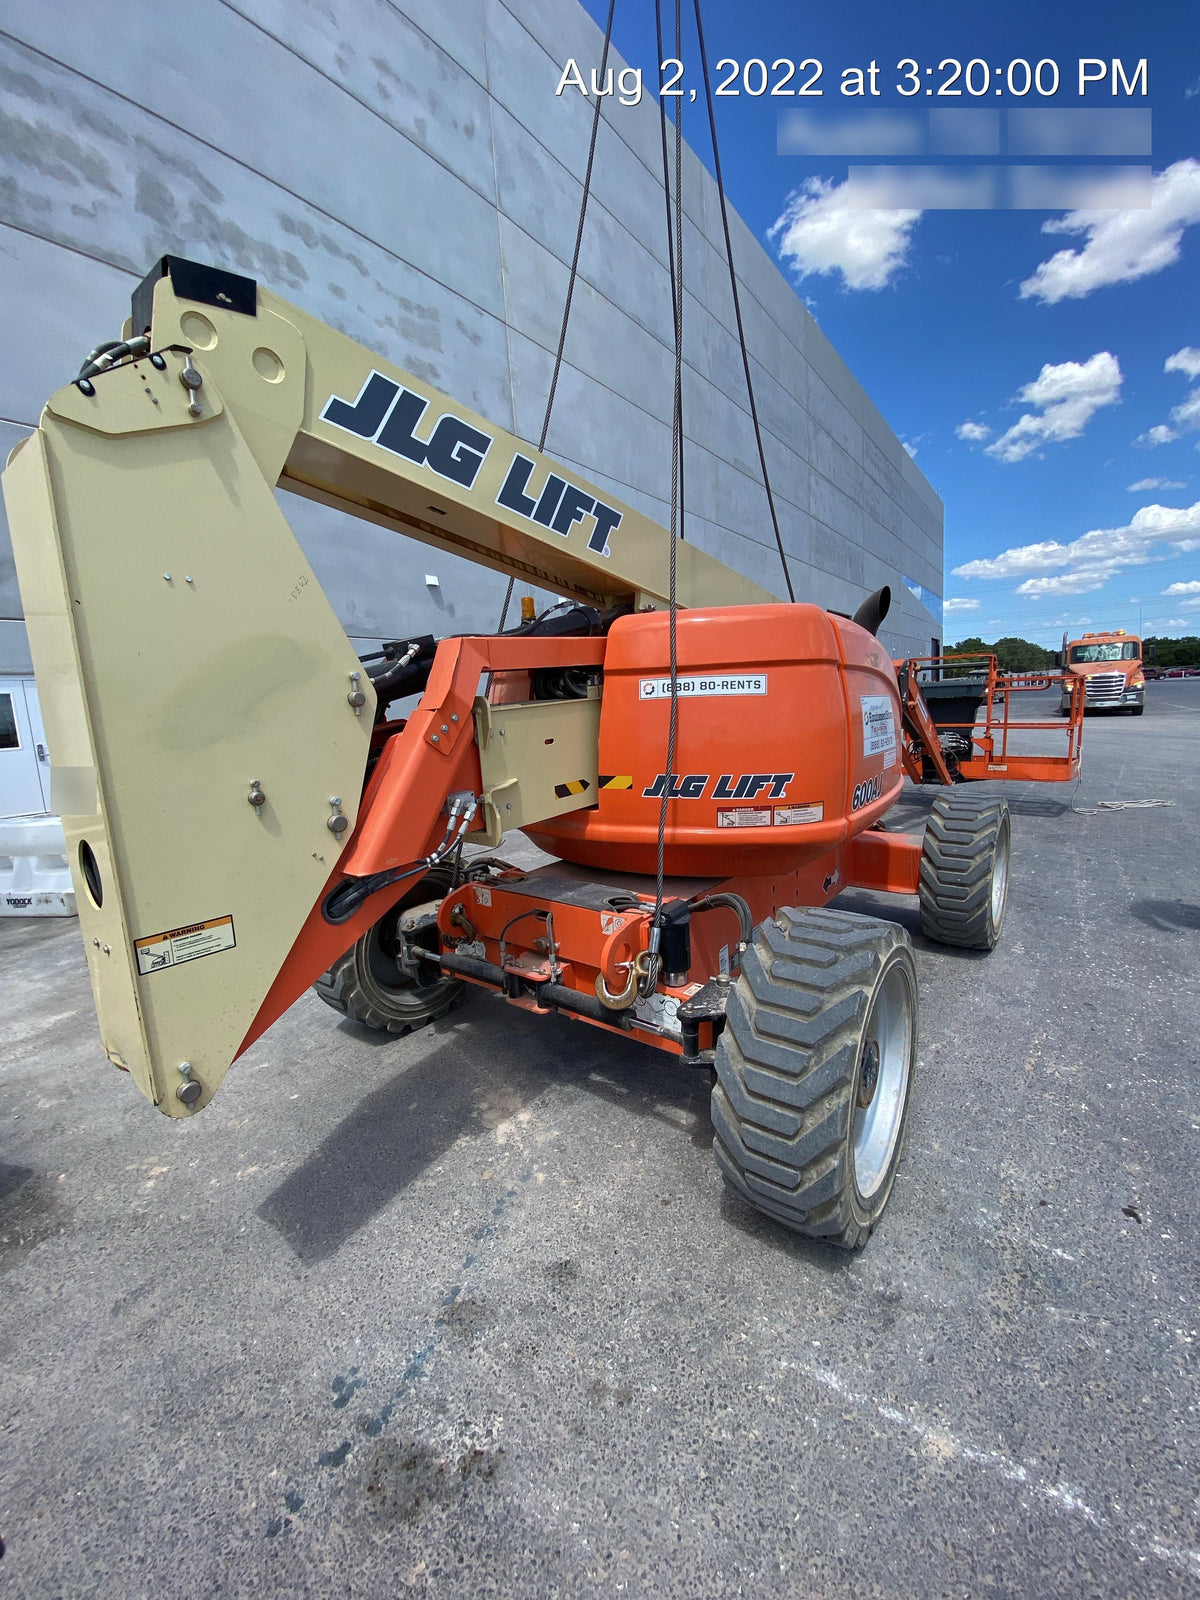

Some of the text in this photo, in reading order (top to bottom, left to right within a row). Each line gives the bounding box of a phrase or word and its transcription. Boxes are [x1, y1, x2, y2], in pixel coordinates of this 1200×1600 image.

[318, 369, 624, 556] JLG LIFT
[699, 680, 761, 691] 80-RENTS
[641, 773, 795, 799] JLG LIFT
[852, 772, 884, 811] 600AJ
[6, 897, 33, 905] YODOCK
[169, 924, 206, 939] WARNING
